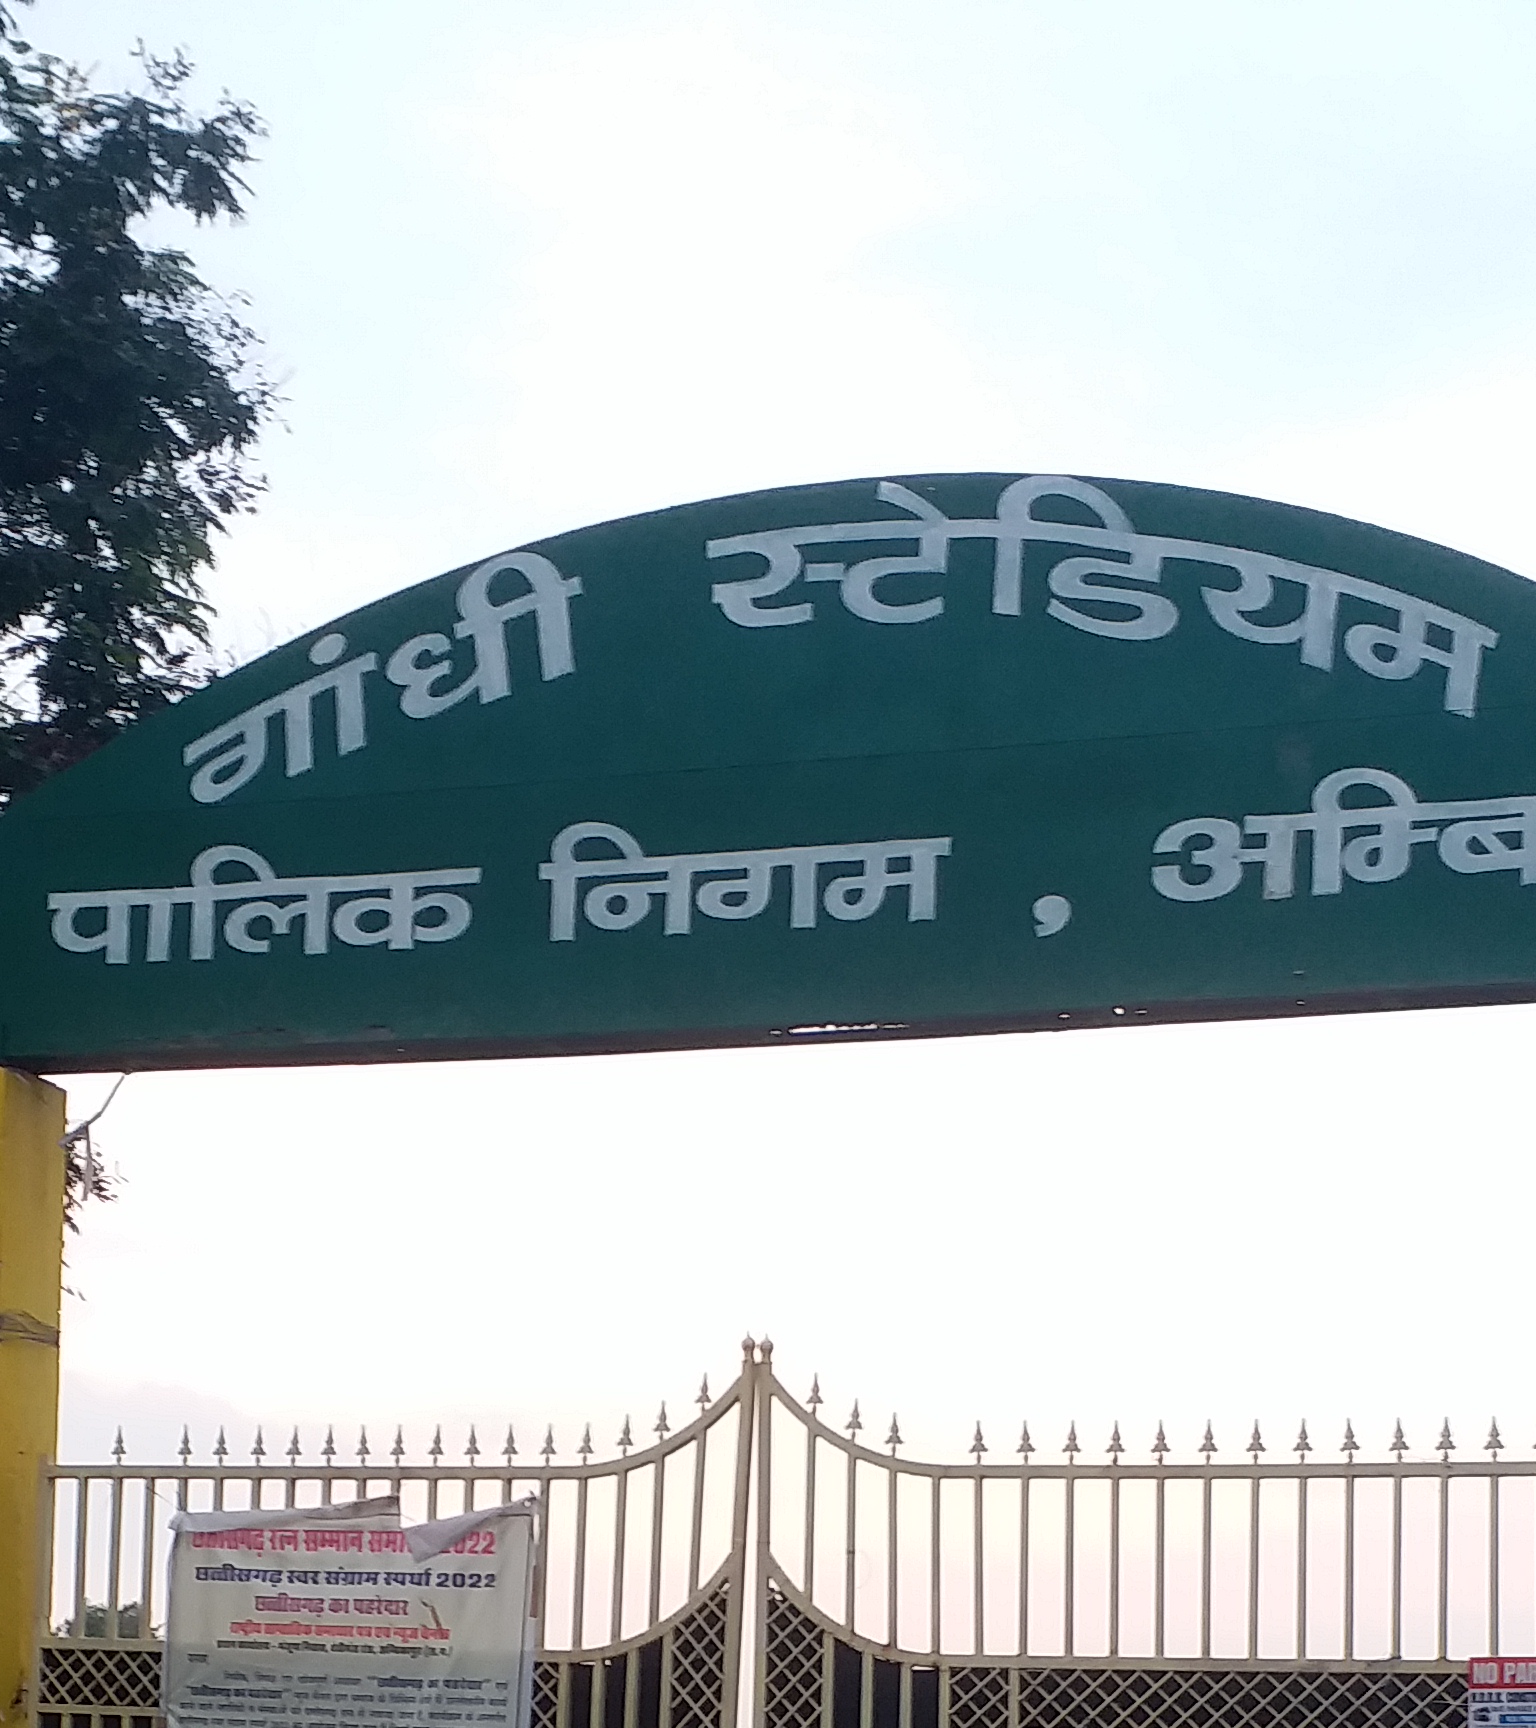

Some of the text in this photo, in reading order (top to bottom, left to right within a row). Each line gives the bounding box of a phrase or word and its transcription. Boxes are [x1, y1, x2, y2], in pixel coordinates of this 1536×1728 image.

[184, 473, 1498, 806] गांधी स्टेडियम
[49, 844, 481, 965] पालिक
[540, 821, 953, 942] निगम
[436, 1573, 496, 1588] 2022
[1472, 1661, 1498, 1684] NO
